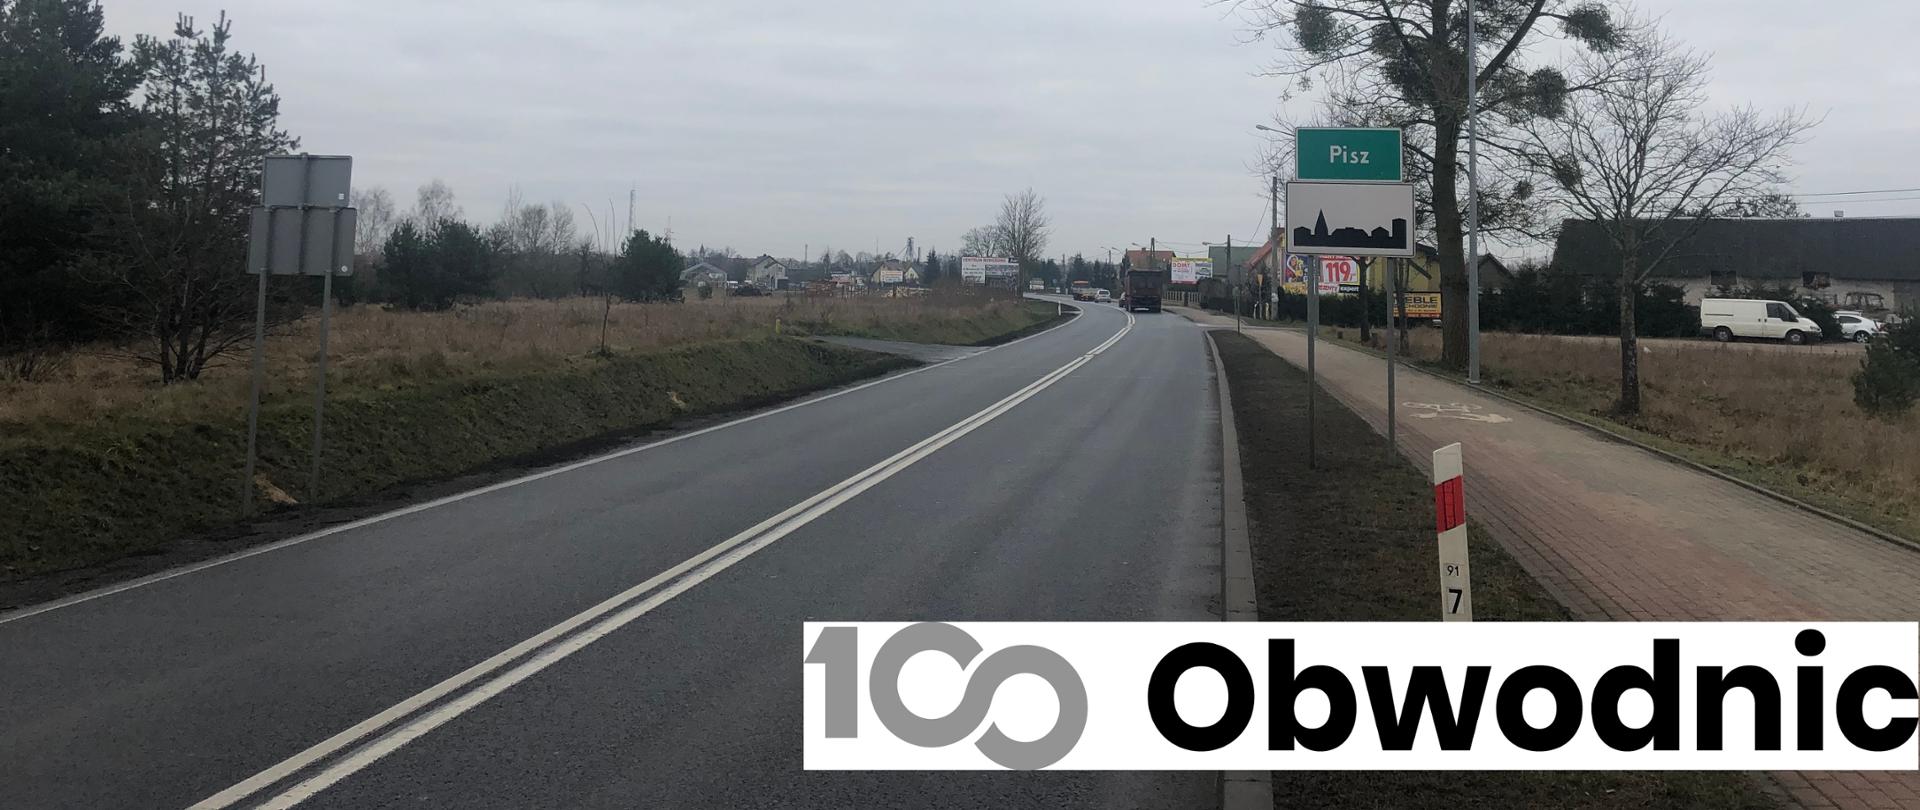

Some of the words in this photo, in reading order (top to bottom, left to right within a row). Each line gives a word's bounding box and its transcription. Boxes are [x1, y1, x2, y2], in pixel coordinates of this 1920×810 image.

[1329, 145, 1370, 164] Pisz
[1403, 296, 1438, 304] EBLE
[1447, 565, 1459, 577] 91
[1449, 588, 1463, 614] 7
